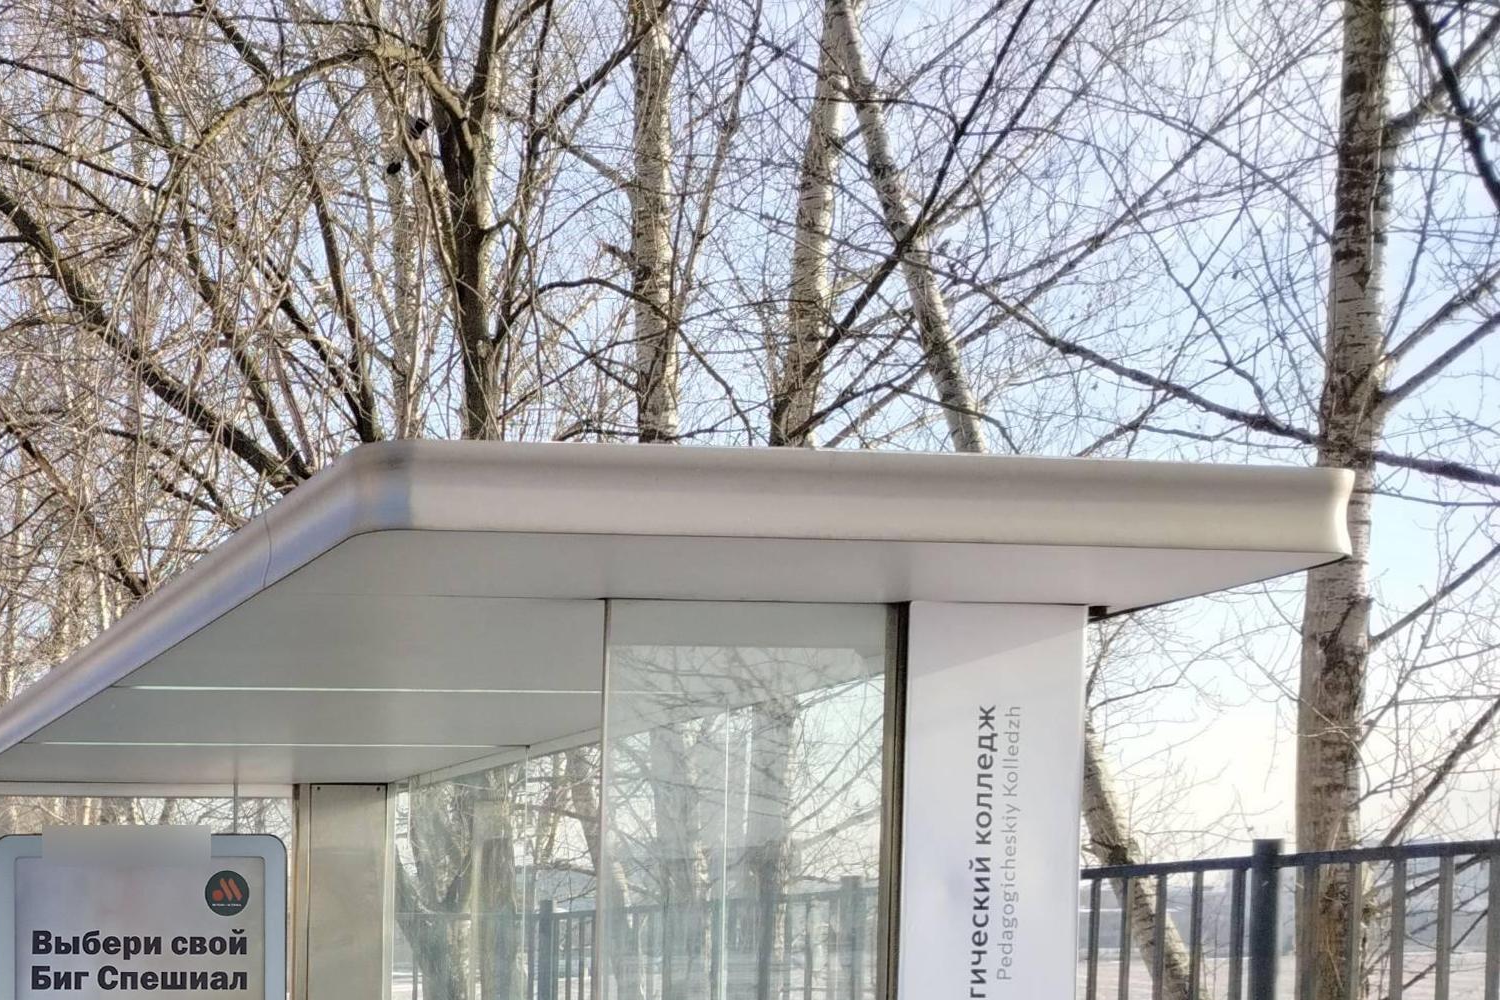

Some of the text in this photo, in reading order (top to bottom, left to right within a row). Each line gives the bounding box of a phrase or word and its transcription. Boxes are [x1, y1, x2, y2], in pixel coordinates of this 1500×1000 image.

[975, 704, 999, 845] колледж
[996, 705, 1021, 981] Pedagogicheskiy Kolledzh
[31, 928, 248, 961] Выбери свой
[31, 965, 248, 991] Биг Спешиал
